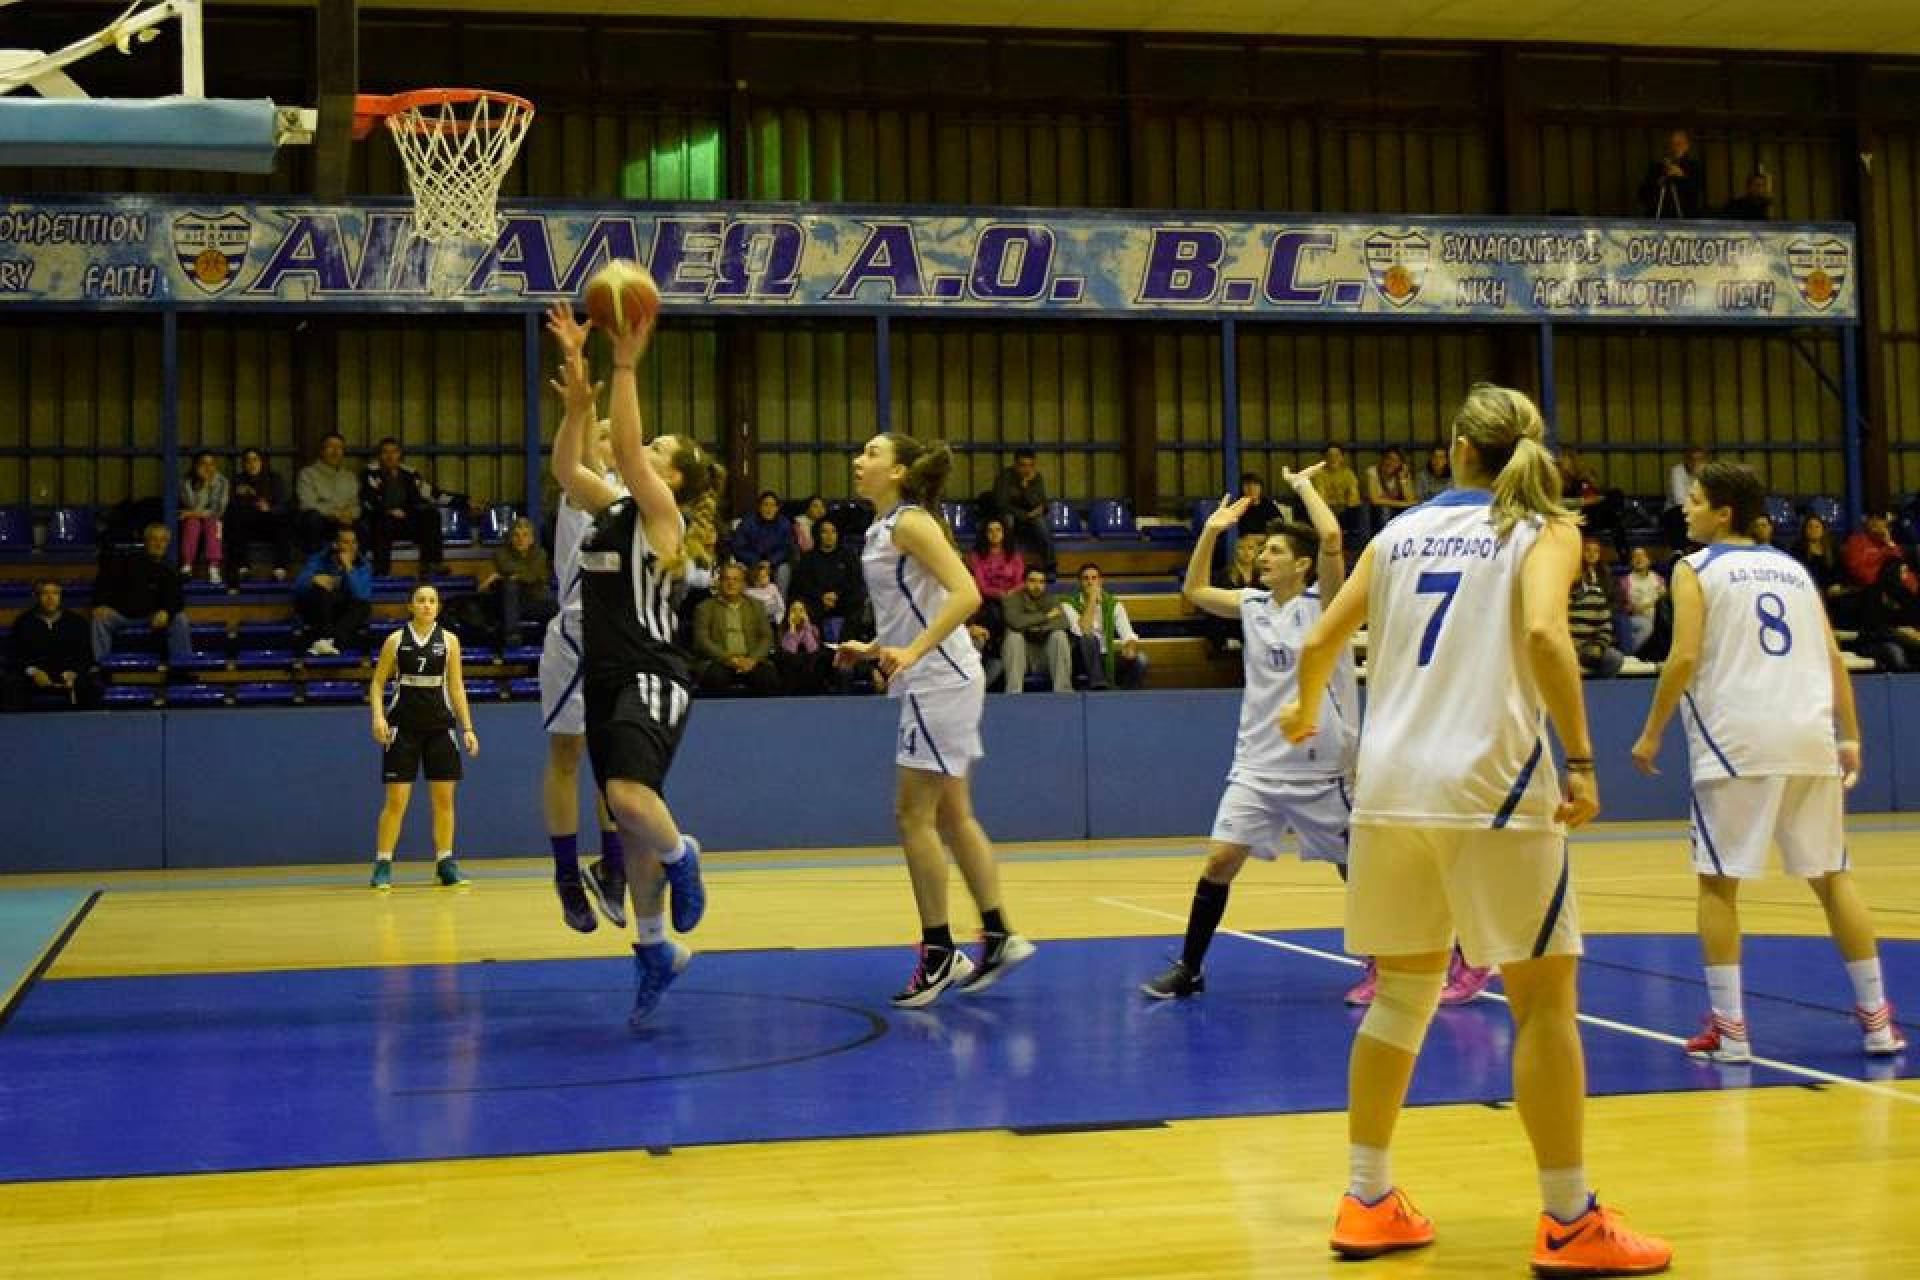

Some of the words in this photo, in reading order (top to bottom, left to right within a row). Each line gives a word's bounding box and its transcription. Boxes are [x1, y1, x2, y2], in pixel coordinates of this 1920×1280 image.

[84, 263, 157, 298] FAITH
[1416, 571, 1462, 667] 7
[1756, 592, 1793, 656] 8
[416, 656, 428, 673] 7
